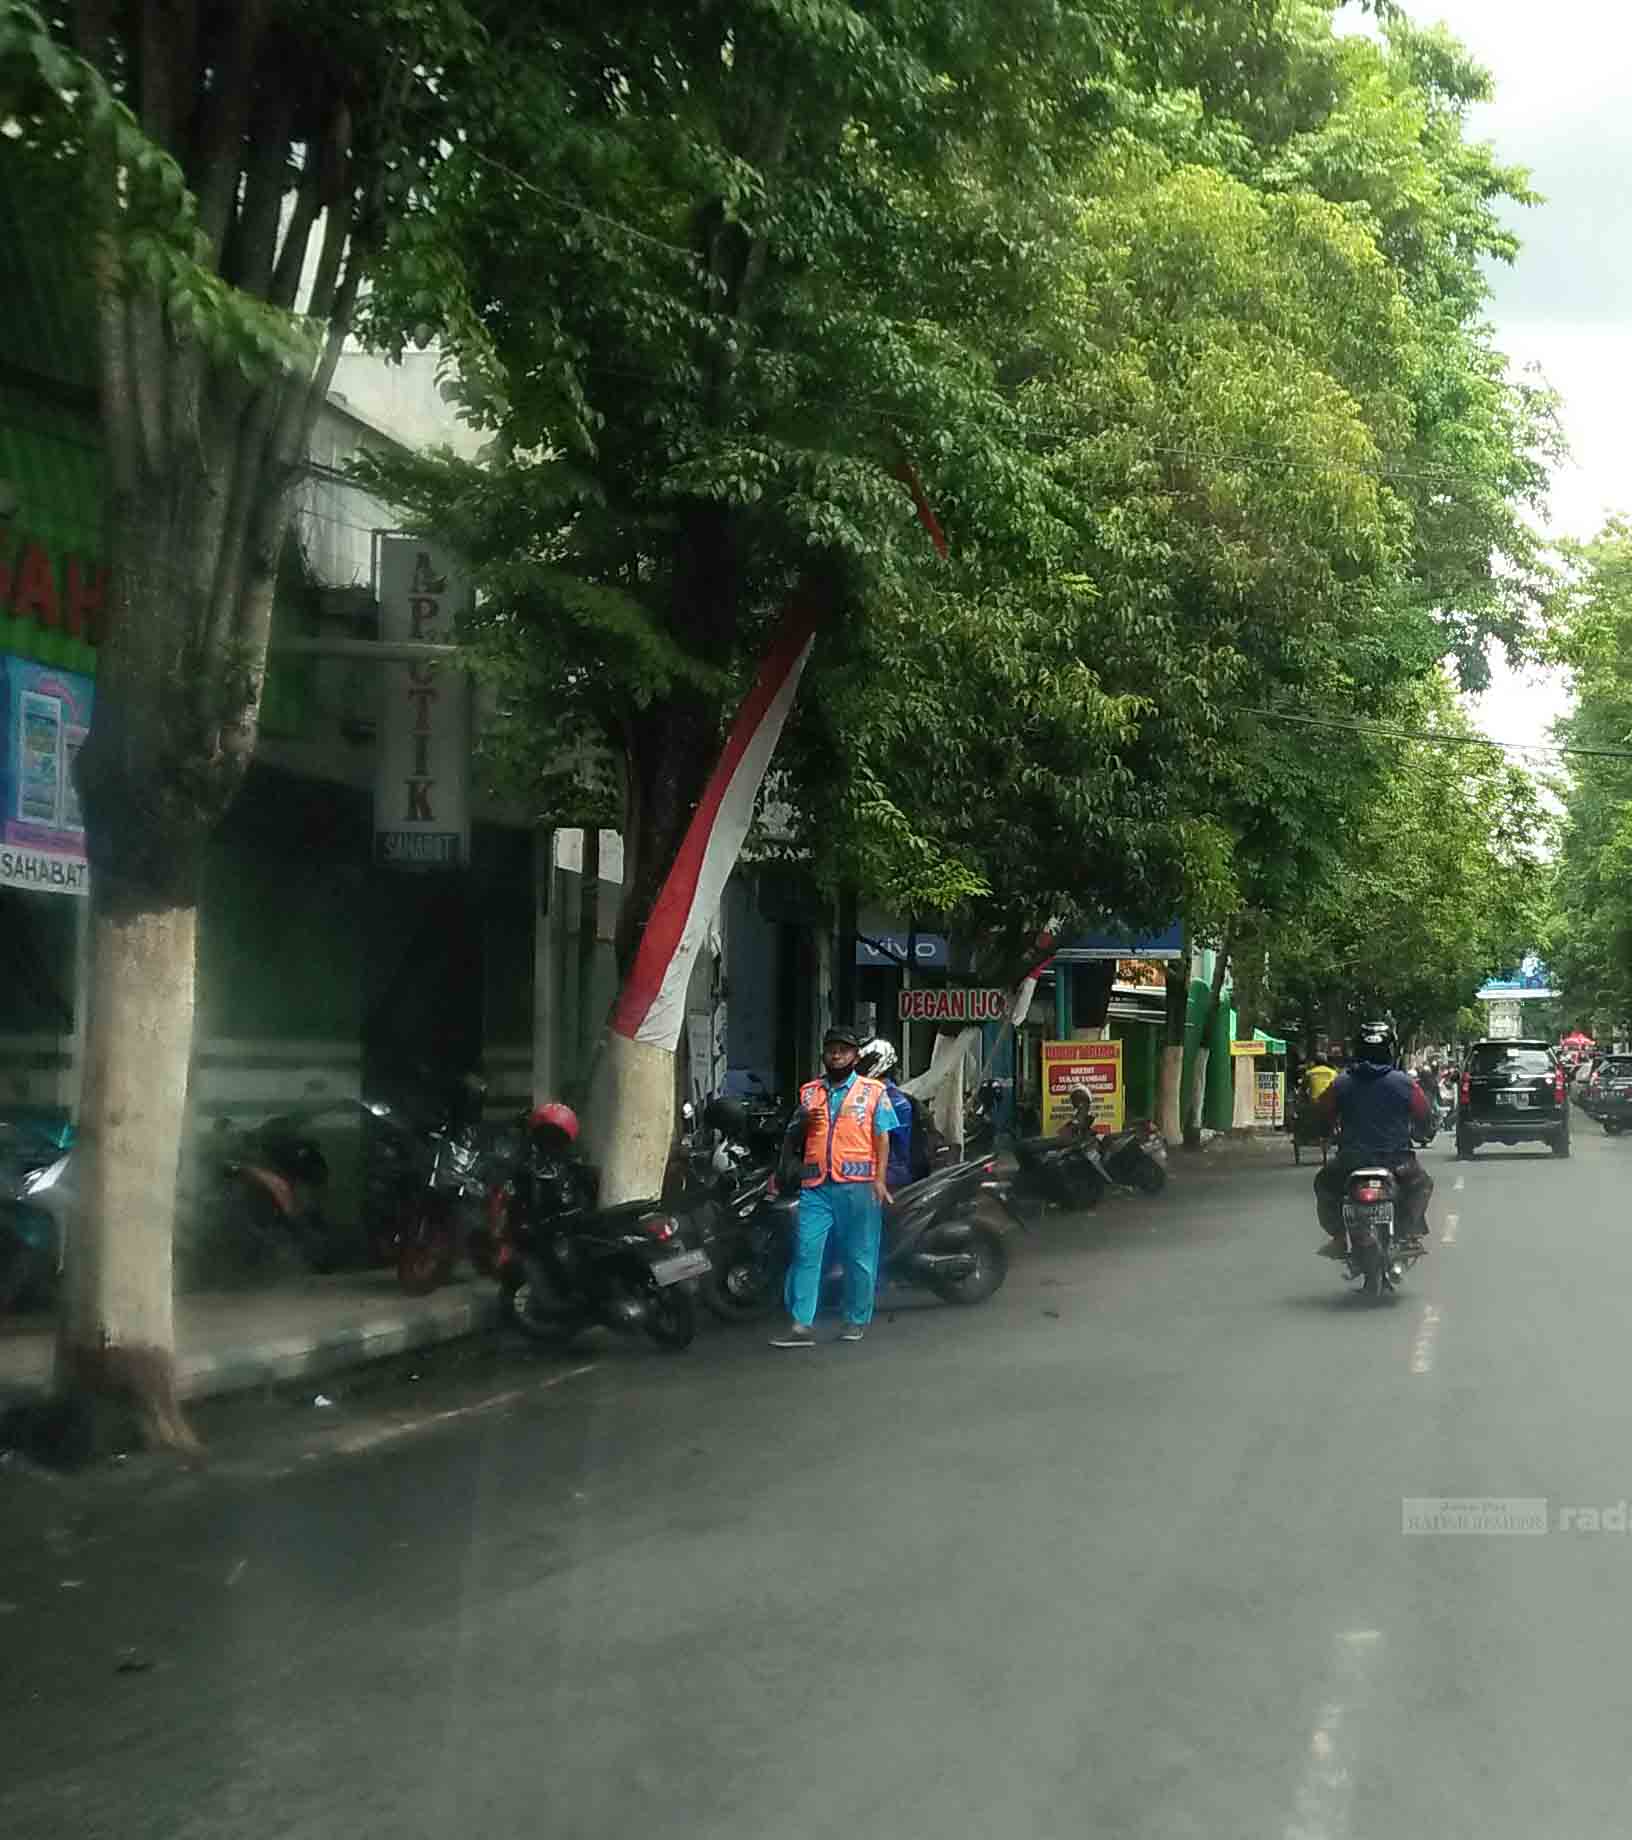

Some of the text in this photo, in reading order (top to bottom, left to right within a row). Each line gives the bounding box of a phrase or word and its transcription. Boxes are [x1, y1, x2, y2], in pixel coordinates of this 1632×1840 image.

[1, 853, 87, 889] SAHABAT
[864, 937, 937, 957] vivo
[900, 990, 966, 1019] DEGAN
